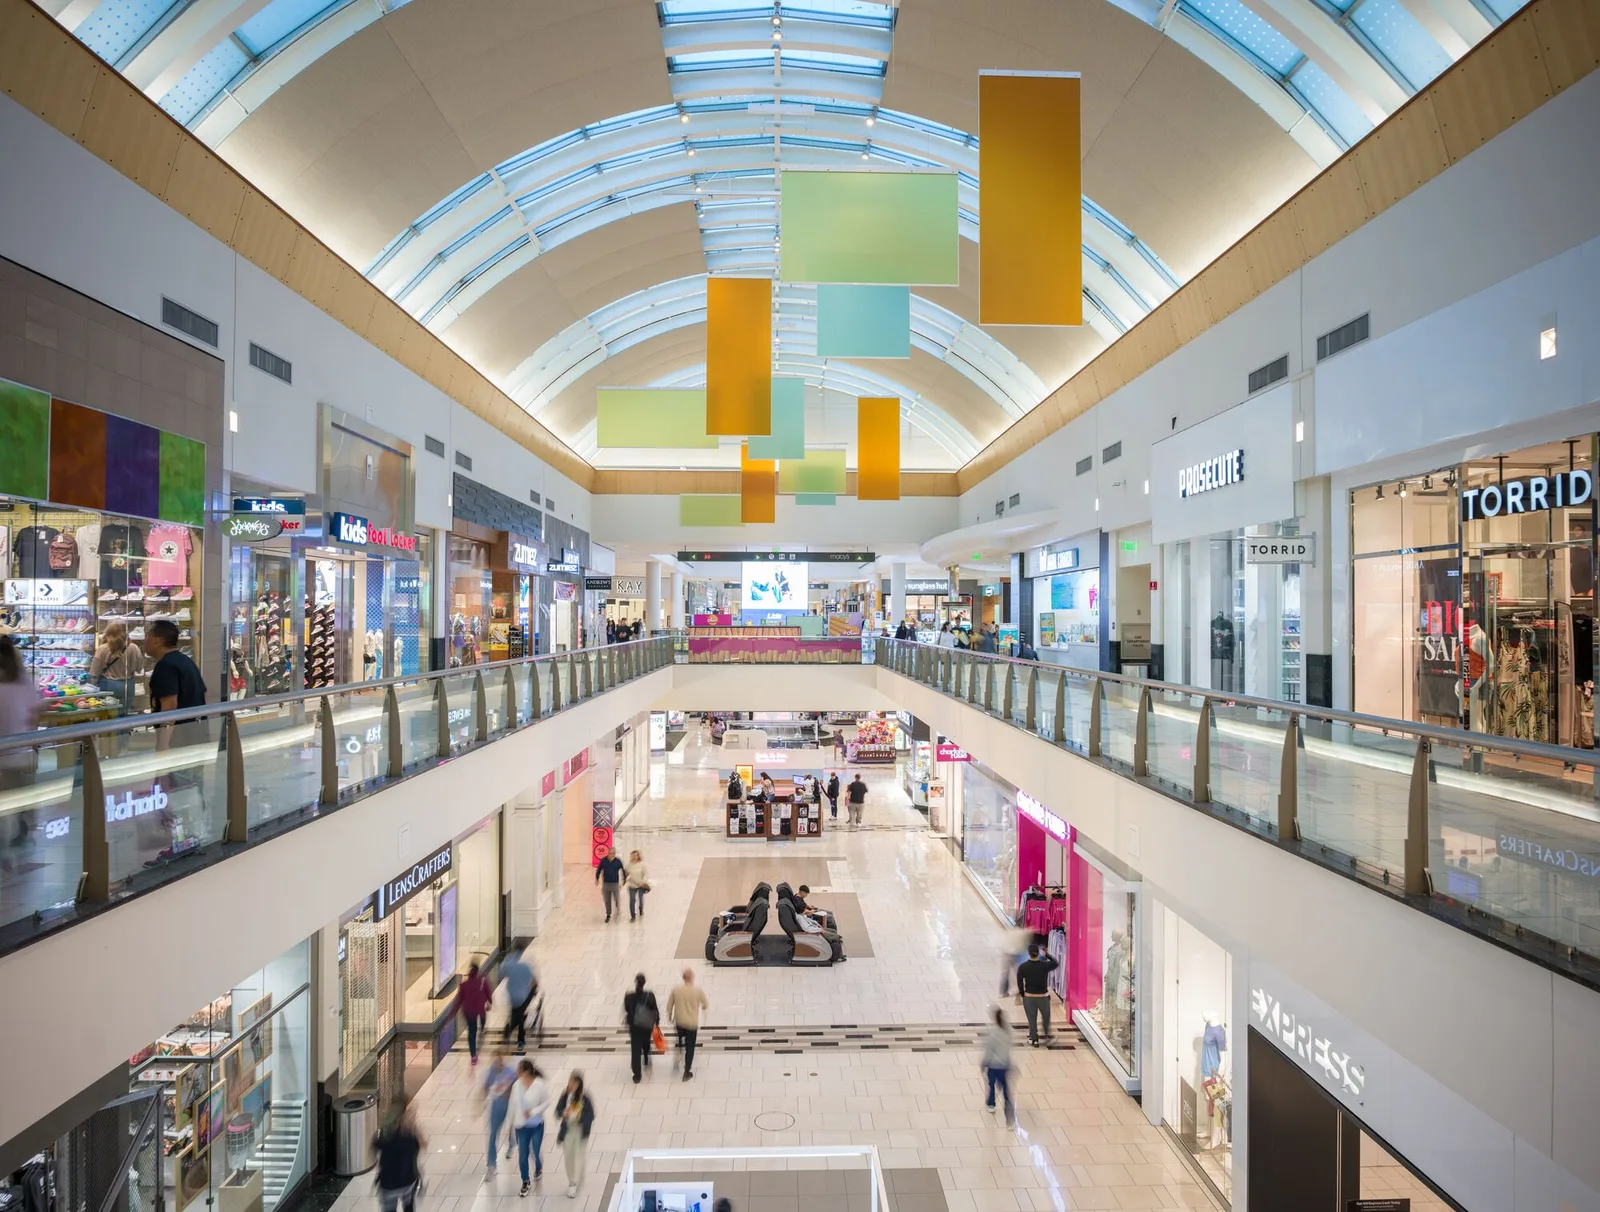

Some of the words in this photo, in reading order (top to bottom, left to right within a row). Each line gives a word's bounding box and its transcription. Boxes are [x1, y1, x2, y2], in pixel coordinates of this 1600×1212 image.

[1179, 449, 1243, 498] PROSECUTE
[1462, 469, 1592, 520] TORRID
[340, 515, 367, 545] kids
[390, 528, 416, 550] Locker
[1250, 545, 1306, 555] TORRID
[616, 580, 642, 590] KAY
[907, 583, 935, 591] sunglass
[936, 582, 948, 590] hut
[1424, 635, 1458, 662] SAL
[1249, 987, 1365, 1100] EXPRESS
